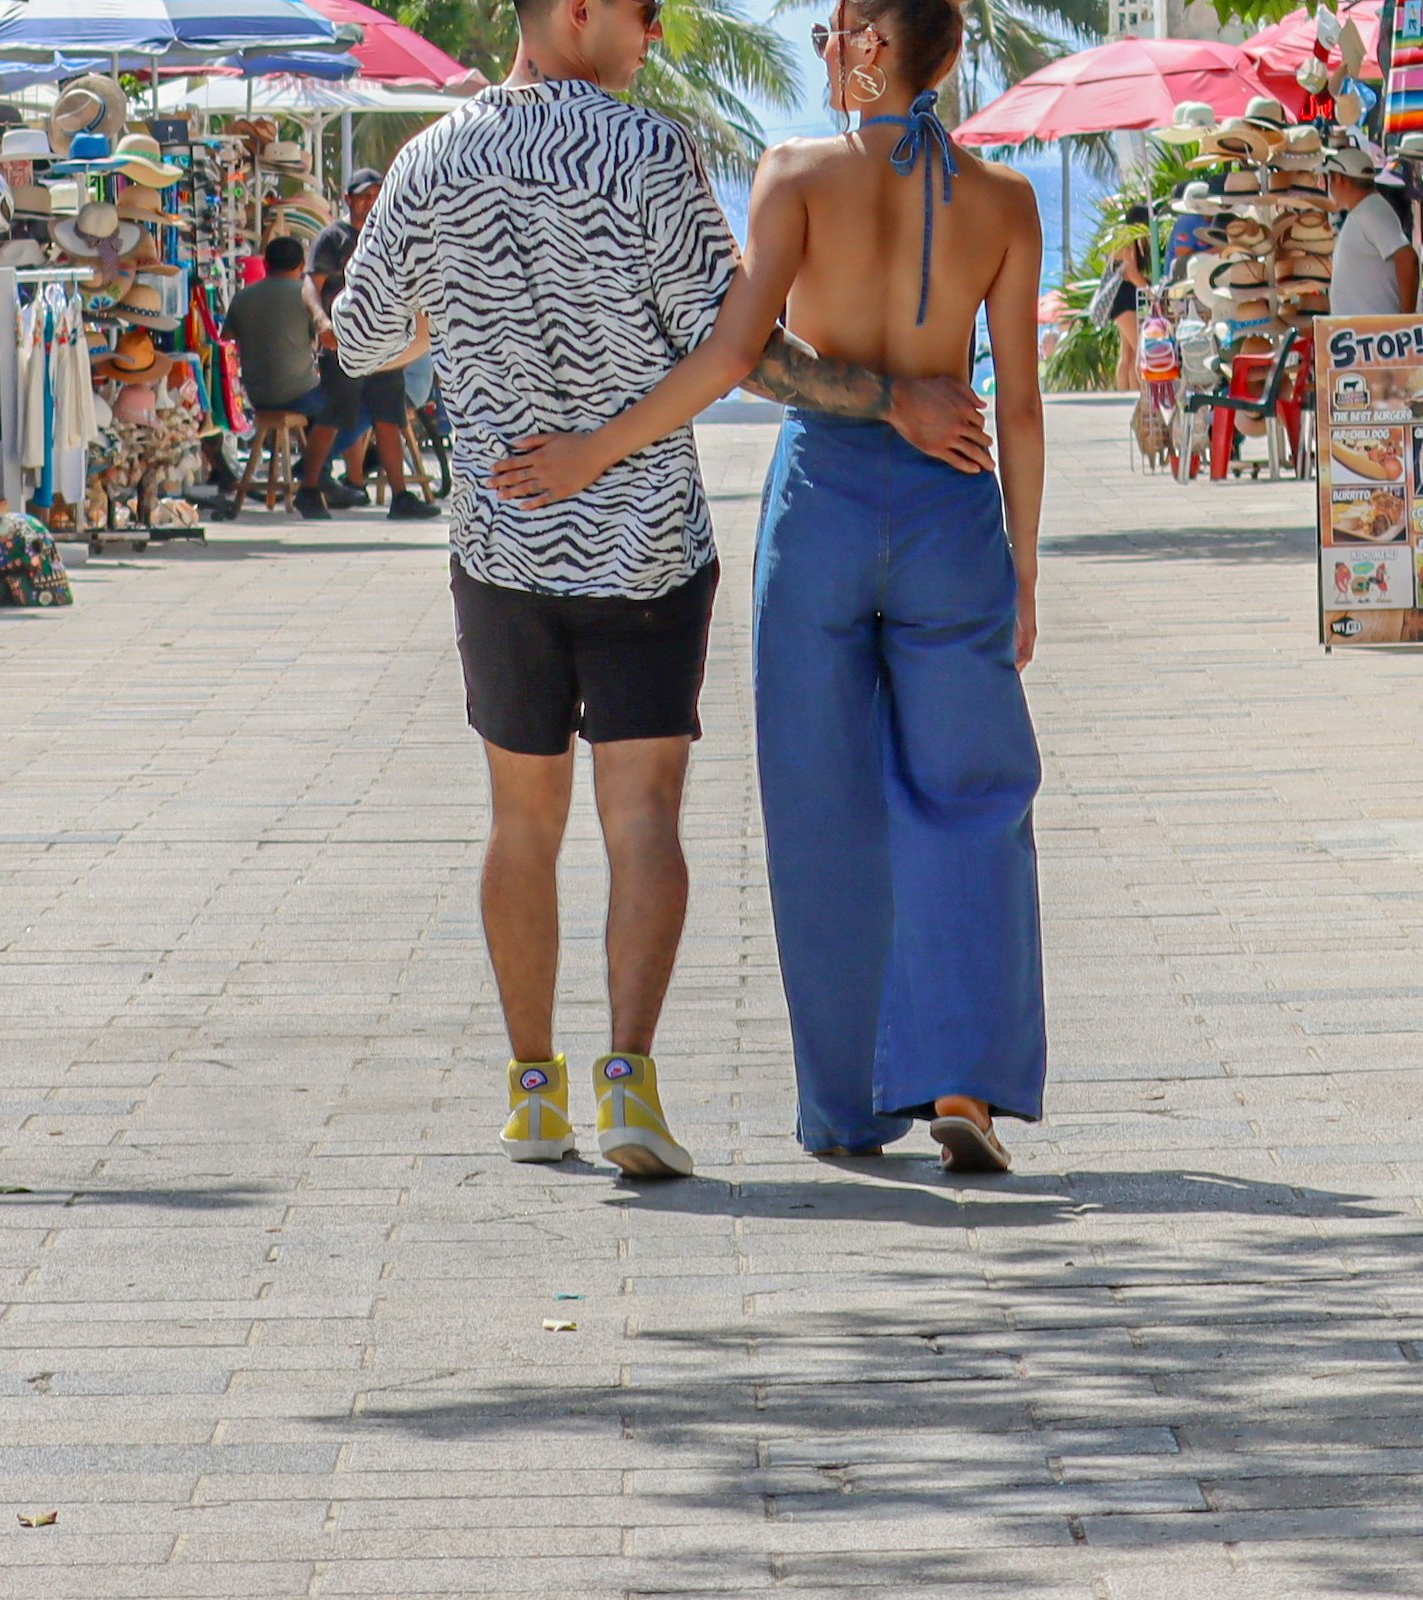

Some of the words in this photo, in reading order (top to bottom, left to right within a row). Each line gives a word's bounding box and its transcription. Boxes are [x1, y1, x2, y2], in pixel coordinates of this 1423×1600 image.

[1332, 411, 1348, 422] THE
[1350, 410, 1372, 422] BEST
[1373, 408, 1413, 421] BURGERS
[1332, 489, 1371, 502] BURRITO
